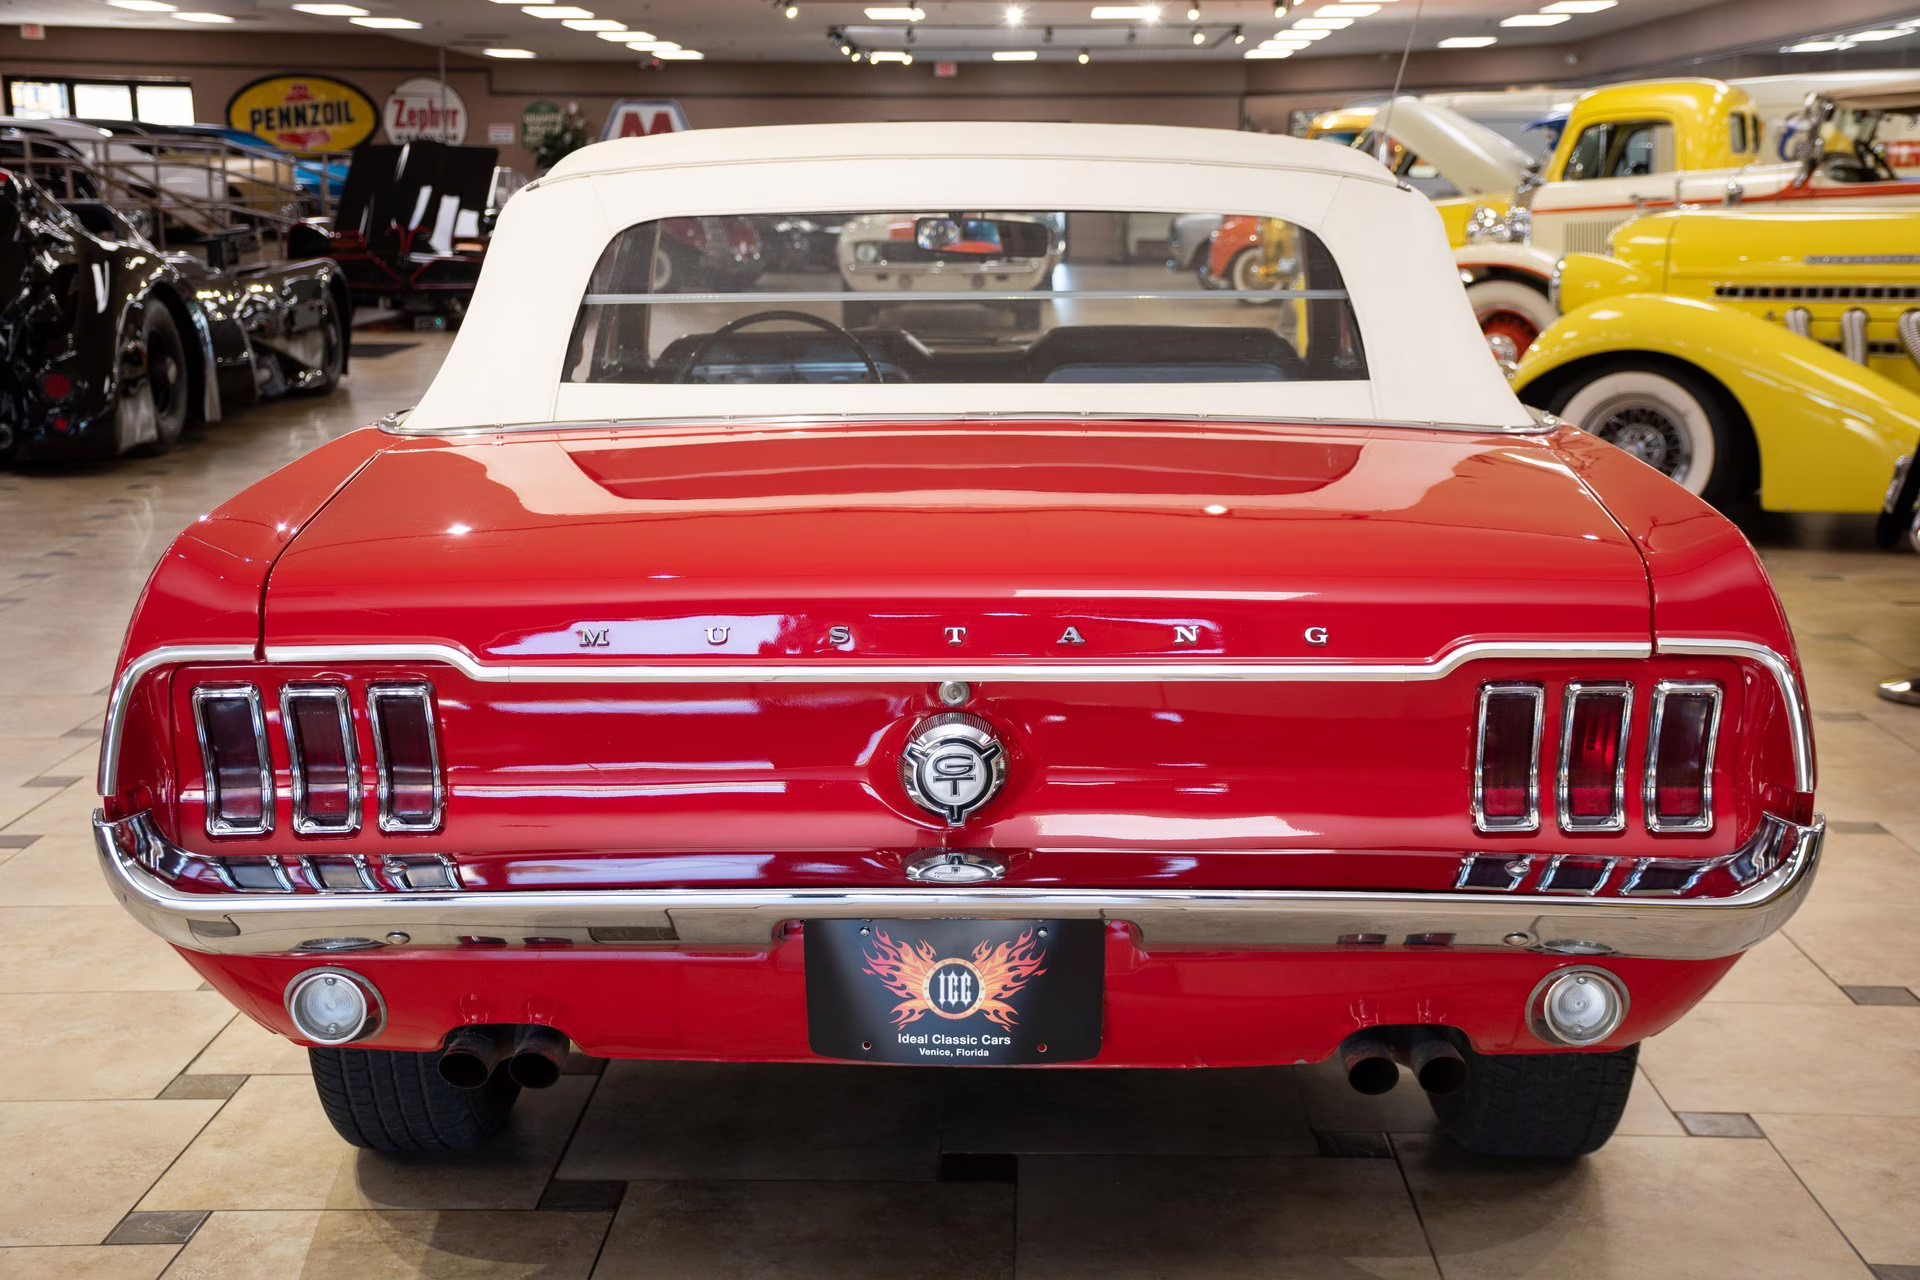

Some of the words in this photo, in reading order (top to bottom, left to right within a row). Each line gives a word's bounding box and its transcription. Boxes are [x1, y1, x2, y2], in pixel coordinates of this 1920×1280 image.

[250, 100, 355, 131] PENNZOIL
[391, 98, 459, 132] Zephyr
[579, 625, 1330, 647] MUSTANG
[897, 1033, 928, 1044] Ideal
[931, 1034, 978, 1045] Classic
[981, 1034, 1011, 1045] Cars
[919, 1047, 954, 1057] Venice,
[956, 1048, 989, 1057] Florida
